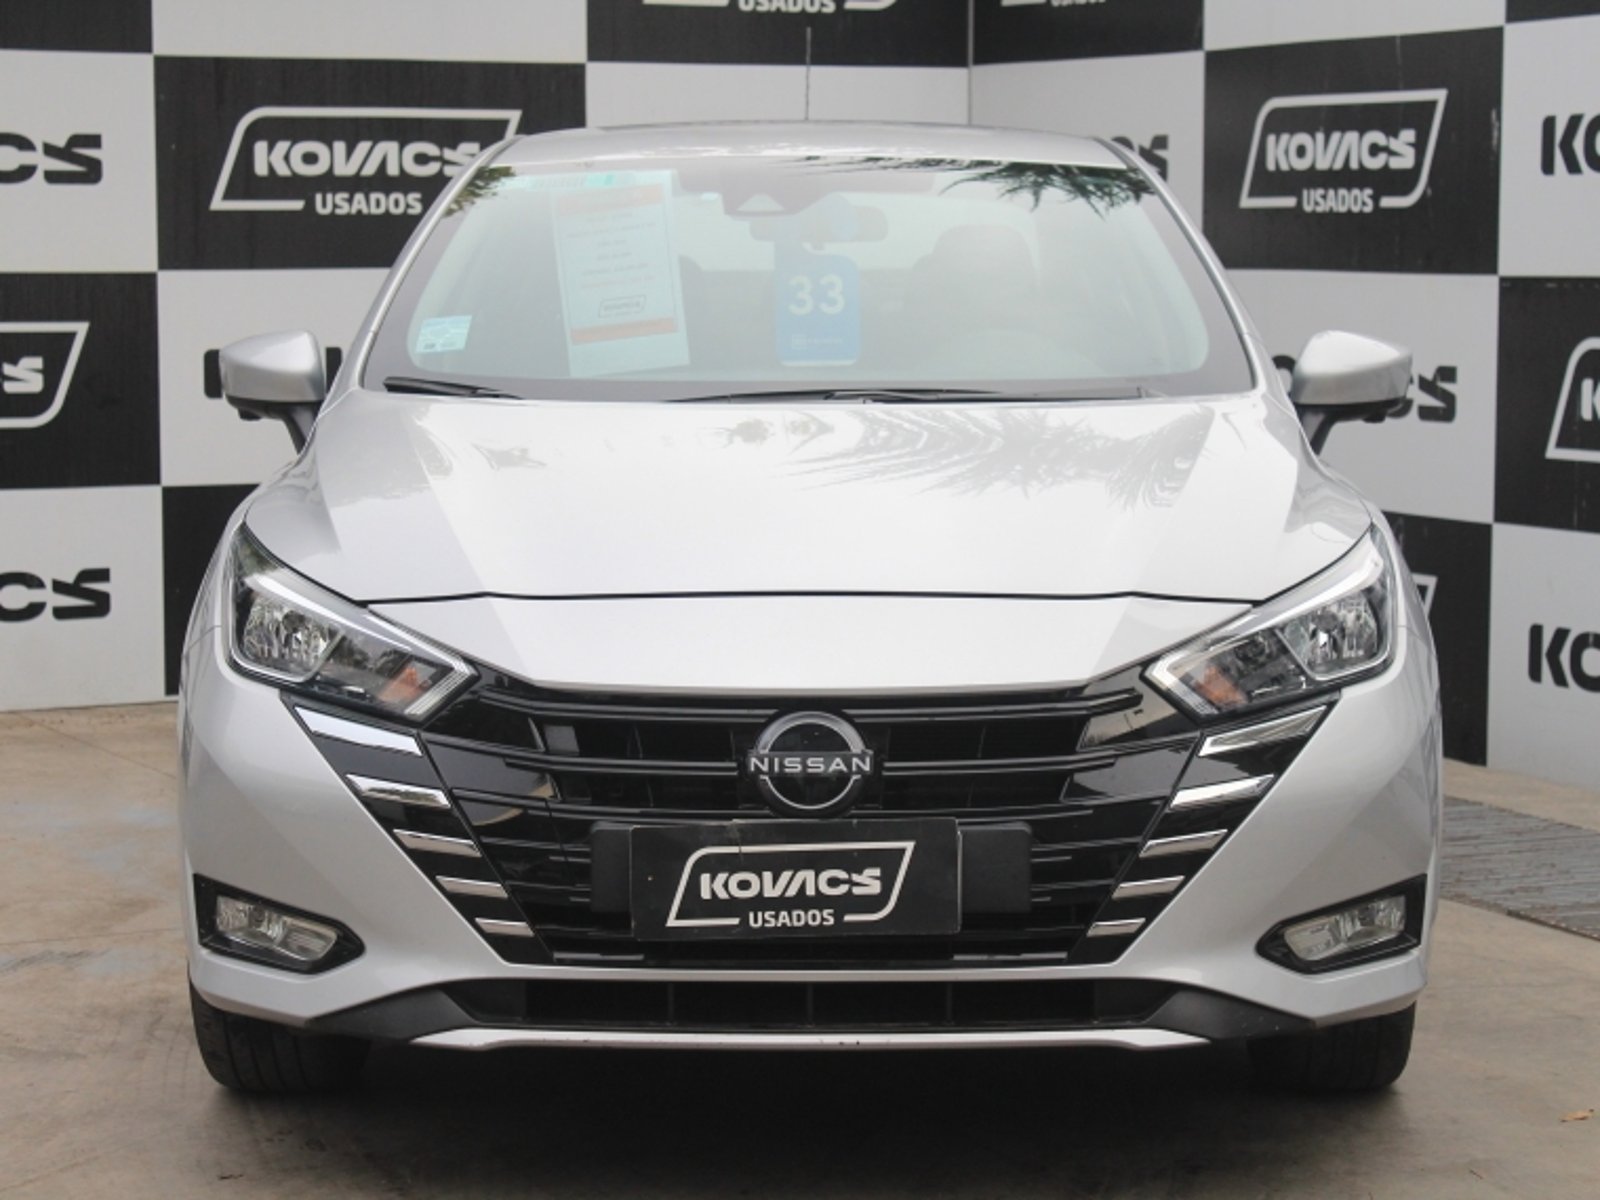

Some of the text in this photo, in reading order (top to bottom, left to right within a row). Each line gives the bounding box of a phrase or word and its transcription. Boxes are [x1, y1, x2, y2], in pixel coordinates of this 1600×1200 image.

[253, 140, 481, 178] KOVACS
[1265, 128, 1417, 172] KOVACS
[314, 192, 423, 216] USADOS
[1302, 187, 1374, 214] USADOS
[787, 273, 846, 317] 33
[749, 756, 871, 773] NISSAN
[700, 867, 882, 900] KOVACS
[748, 909, 835, 928] USADOS
